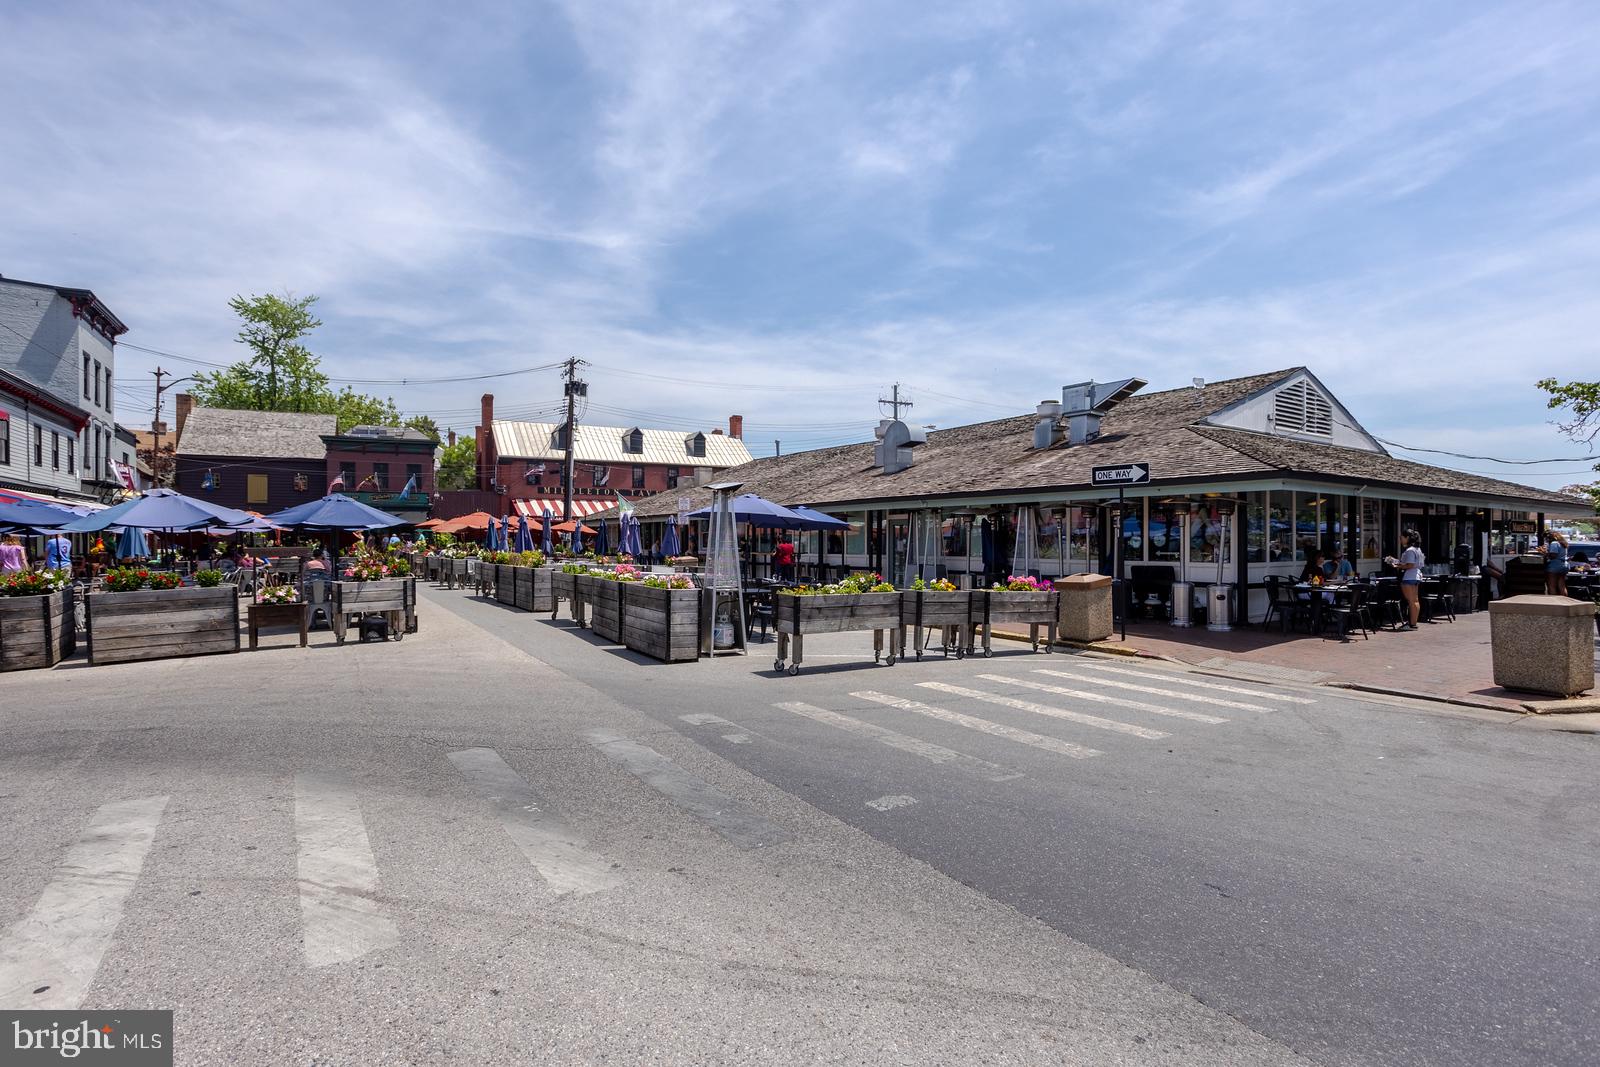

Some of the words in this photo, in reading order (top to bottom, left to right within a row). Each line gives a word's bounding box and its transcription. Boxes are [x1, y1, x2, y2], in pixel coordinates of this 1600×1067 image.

[1097, 471, 1113, 480] ONE
[1115, 470, 1132, 479] WAY
[543, 486, 619, 496] MIDDLETON
